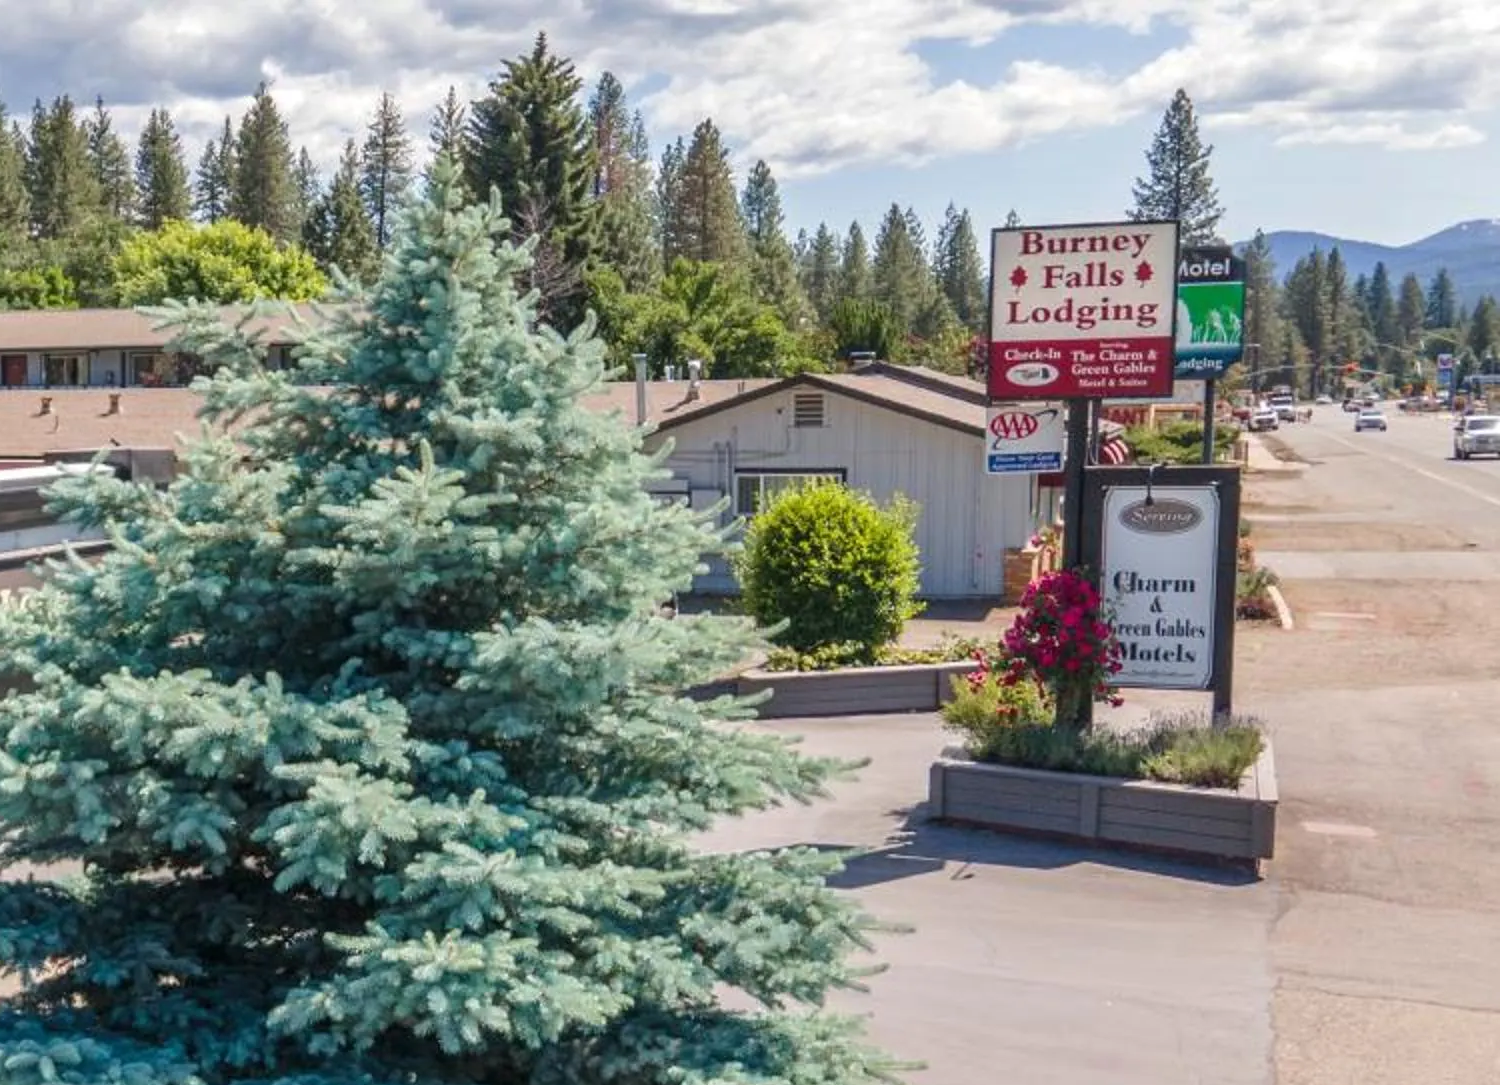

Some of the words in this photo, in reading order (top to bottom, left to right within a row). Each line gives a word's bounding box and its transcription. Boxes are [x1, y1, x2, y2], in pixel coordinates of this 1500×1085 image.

[1020, 230, 1152, 258] Burney
[1041, 261, 1125, 289] Falls
[1006, 297, 1159, 330] Lodging
[1004, 347, 1062, 361] Check-In
[1071, 351, 1096, 363] The
[1099, 349, 1143, 362] Charm
[1147, 349, 1158, 361] &
[1071, 363, 1110, 376] Green
[1112, 361, 1157, 375] Gables
[990, 411, 1038, 439] AAA
[1113, 570, 1196, 594] Charm
[1149, 595, 1163, 613] &
[1155, 617, 1206, 638] Gables
